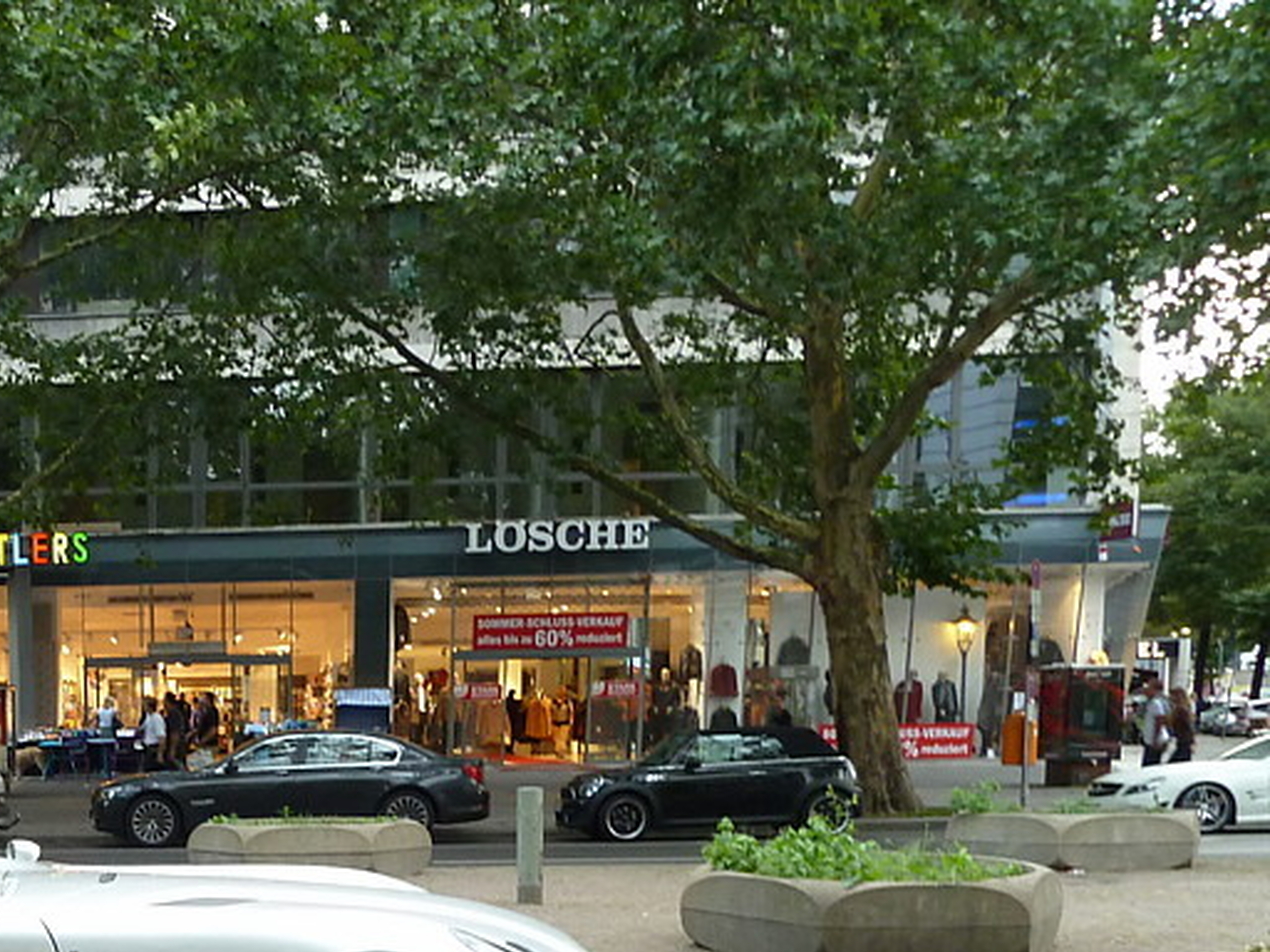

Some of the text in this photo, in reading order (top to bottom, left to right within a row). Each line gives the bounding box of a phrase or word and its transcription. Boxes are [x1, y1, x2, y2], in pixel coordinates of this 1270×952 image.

[478, 629, 623, 648] alles bis zu 60% reduziert
[921, 743, 968, 755] reduziert
